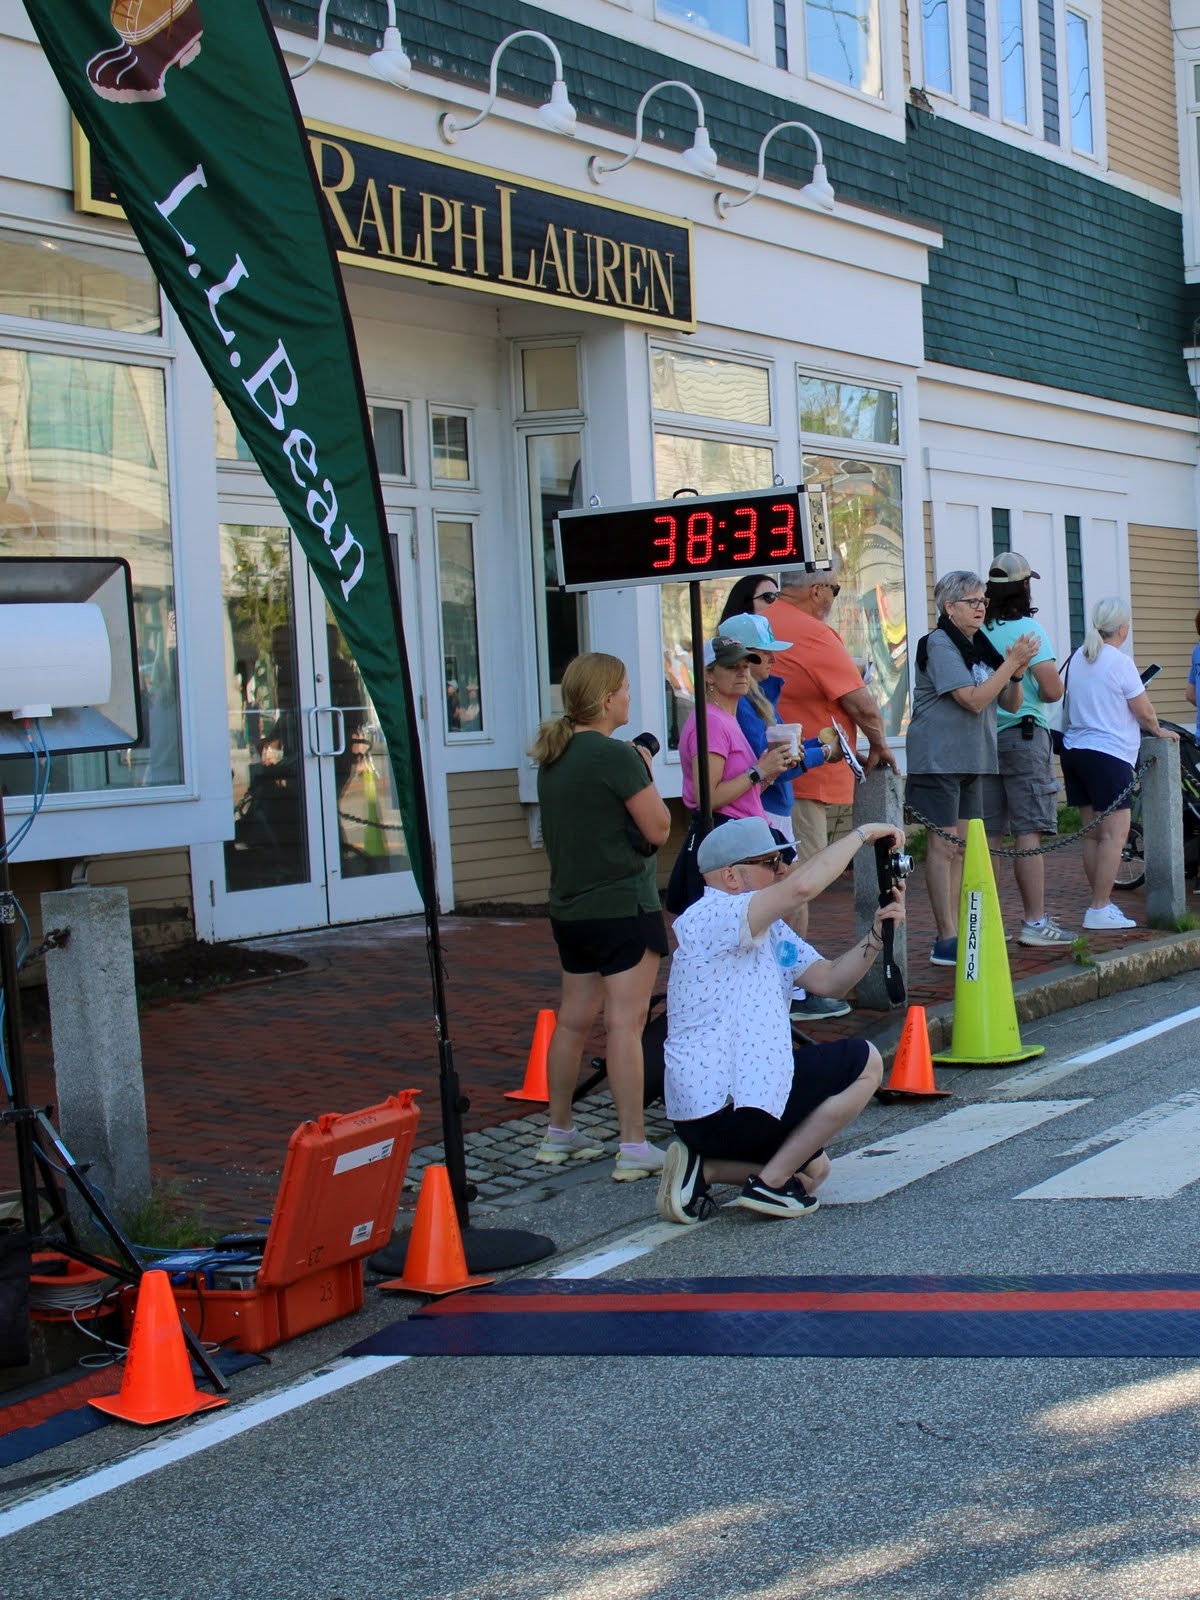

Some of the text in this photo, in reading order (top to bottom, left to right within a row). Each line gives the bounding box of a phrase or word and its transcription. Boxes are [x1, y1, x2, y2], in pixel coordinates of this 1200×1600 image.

[307, 134, 676, 316] RALPH LAUREN
[154, 163, 365, 603] L.L.Bean
[653, 504, 795, 568] 38:33
[968, 913, 977, 950] BEAN
[966, 953, 976, 981] 10K
